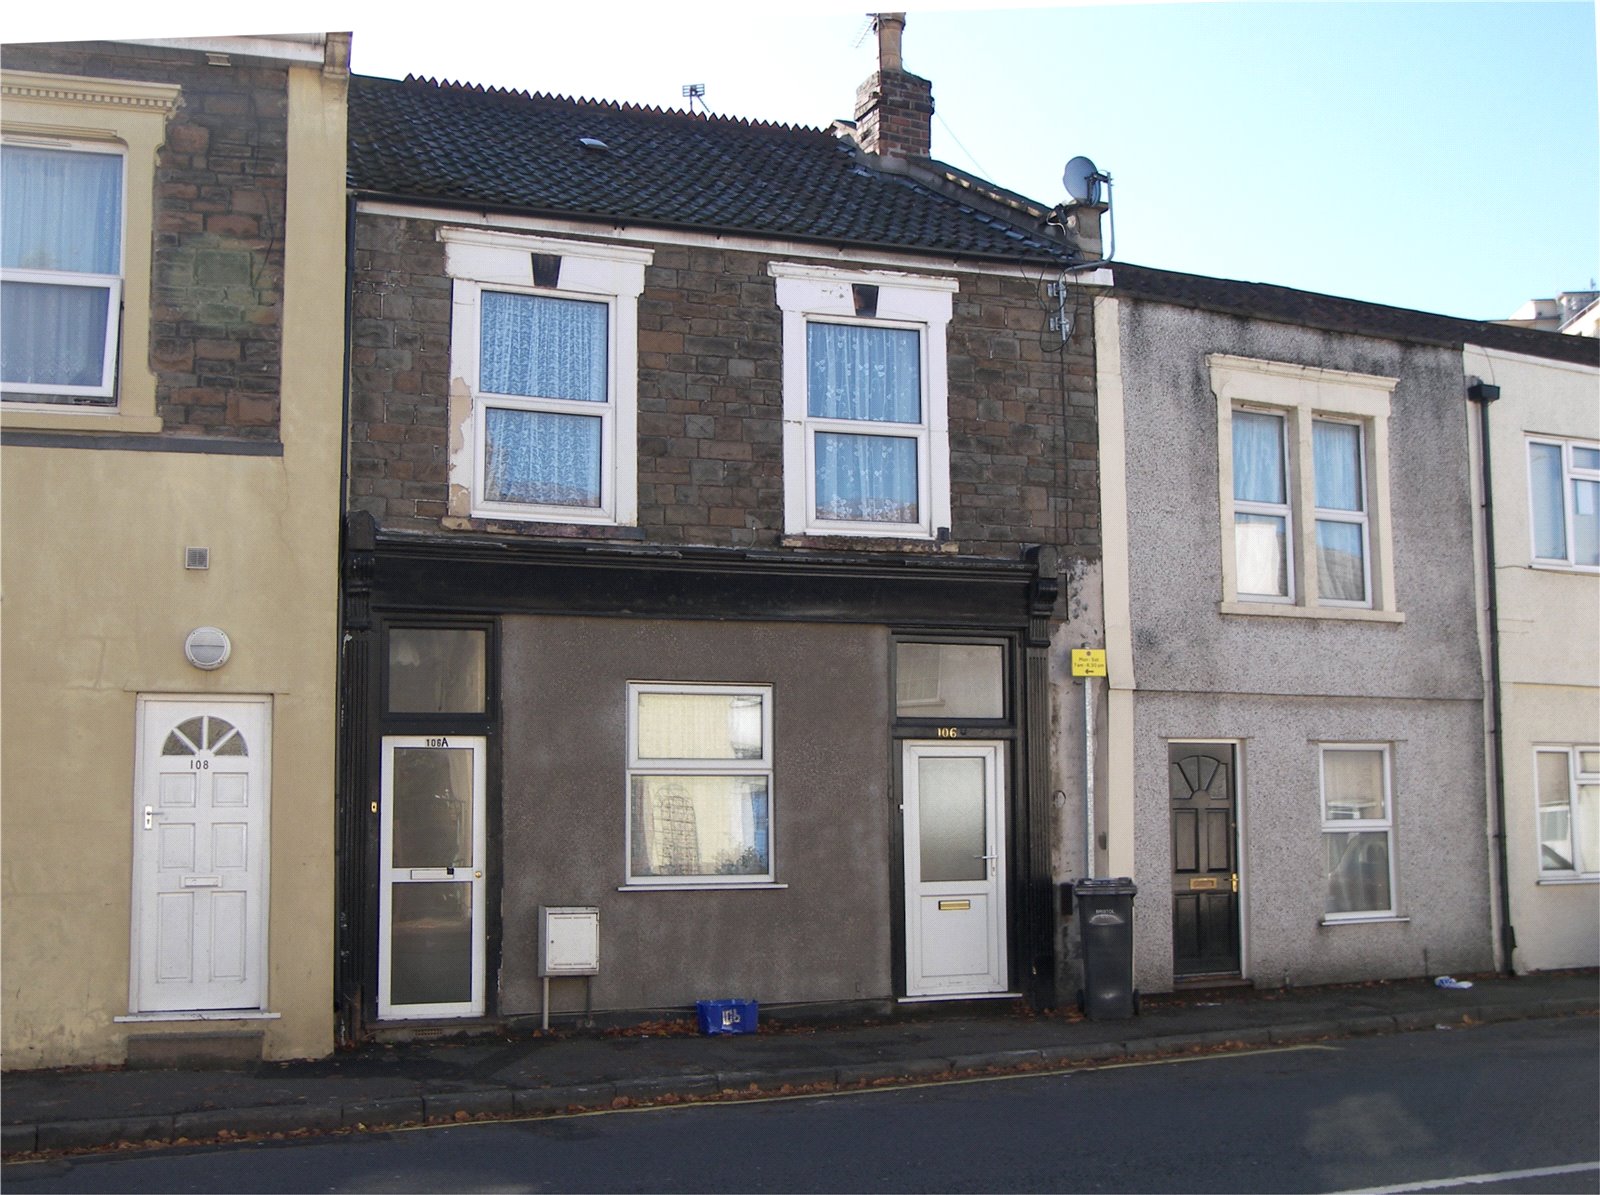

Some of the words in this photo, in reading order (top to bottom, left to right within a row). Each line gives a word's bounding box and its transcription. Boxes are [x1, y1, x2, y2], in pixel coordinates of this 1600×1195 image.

[937, 727, 957, 738] 106
[426, 737, 449, 747] 106A
[190, 759, 209, 770] 108
